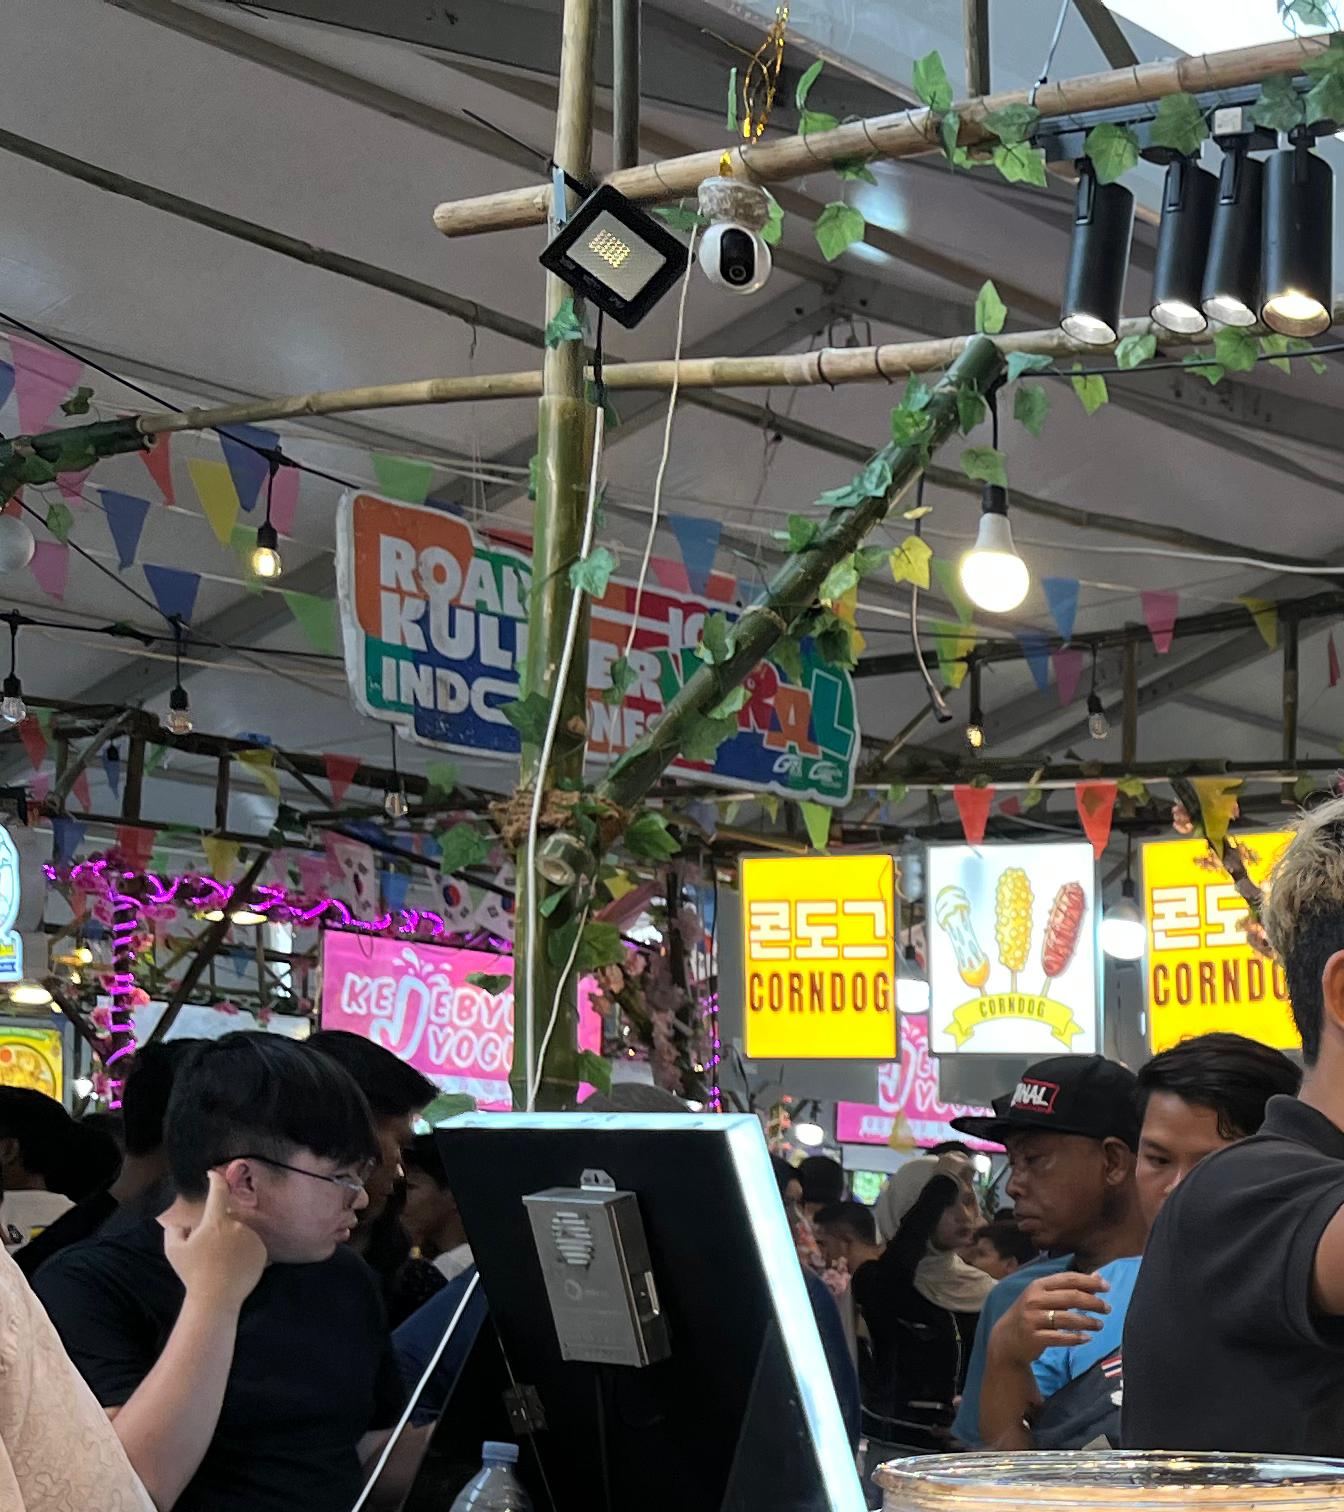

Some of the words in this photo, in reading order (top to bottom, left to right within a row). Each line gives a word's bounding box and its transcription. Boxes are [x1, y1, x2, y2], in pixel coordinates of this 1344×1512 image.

[380, 590, 662, 702] KULIER
[750, 900, 888, 960] 콘도그
[1152, 884, 1250, 951] 콘도
[750, 971, 890, 1013] CORNDOG
[978, 997, 1047, 1018] CORNDOG
[1153, 959, 1287, 1006] CORNDO
